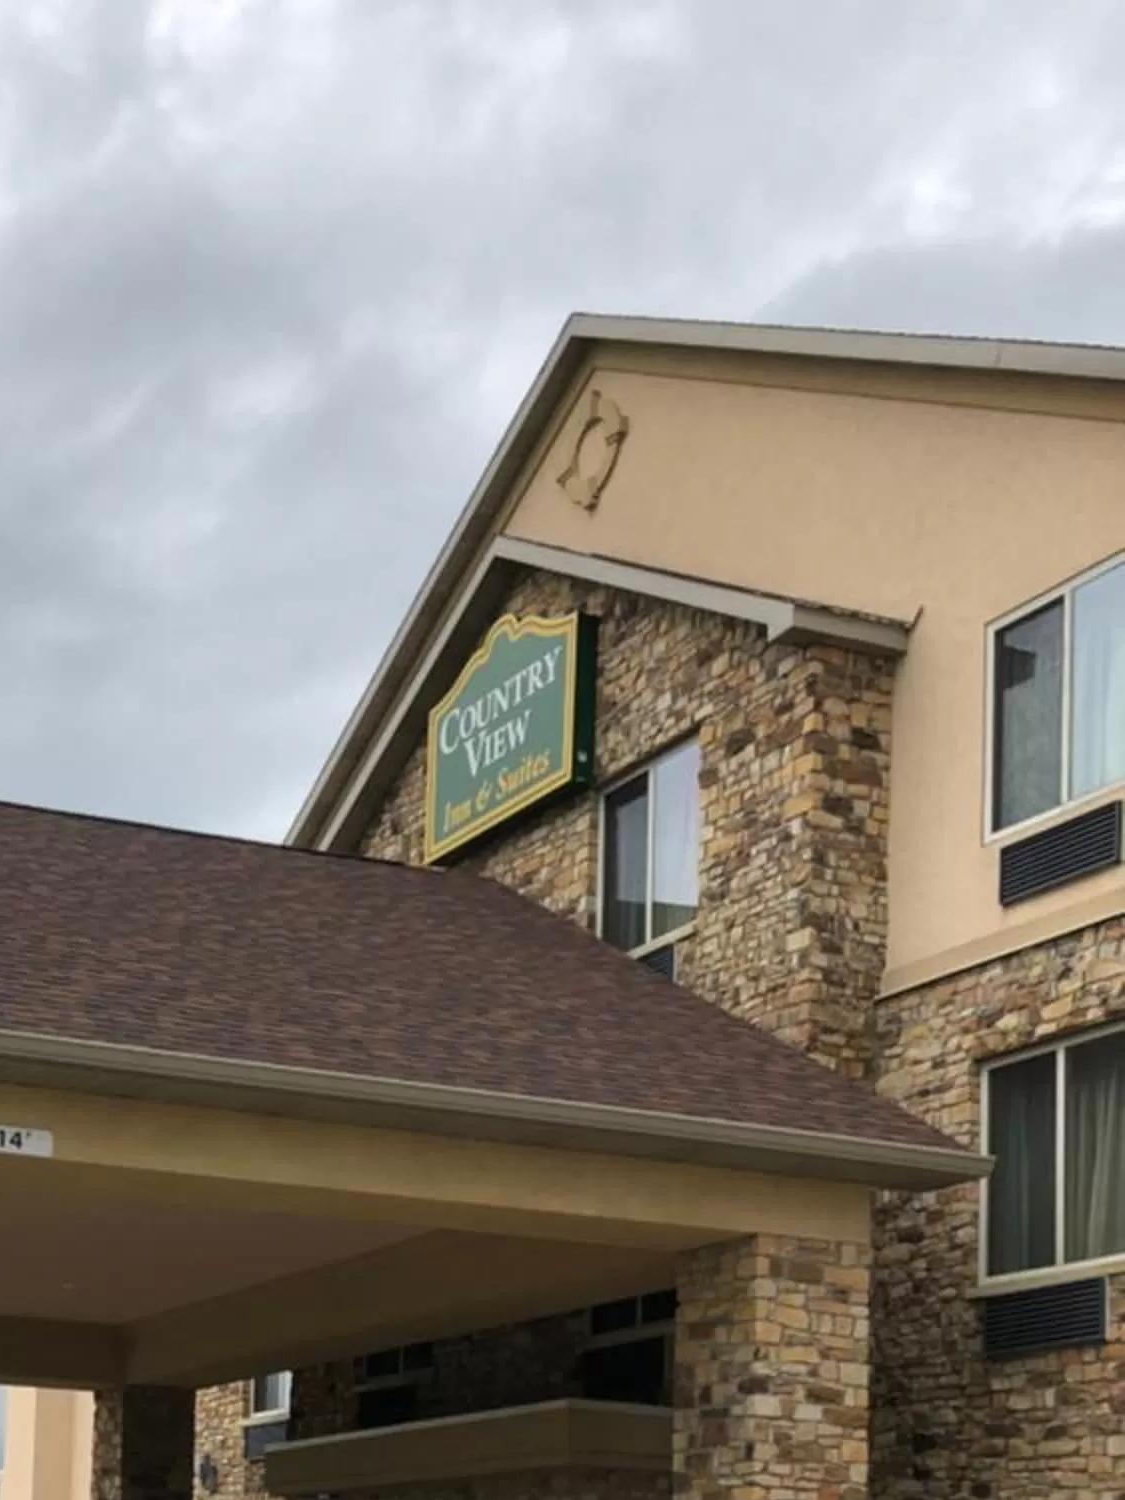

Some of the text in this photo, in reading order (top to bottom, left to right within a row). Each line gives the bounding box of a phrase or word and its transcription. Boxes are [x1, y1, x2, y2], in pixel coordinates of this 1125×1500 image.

[439, 645, 564, 755] COUNTRY
[463, 708, 532, 777] VIEW
[442, 748, 551, 833] Inn & Suites
